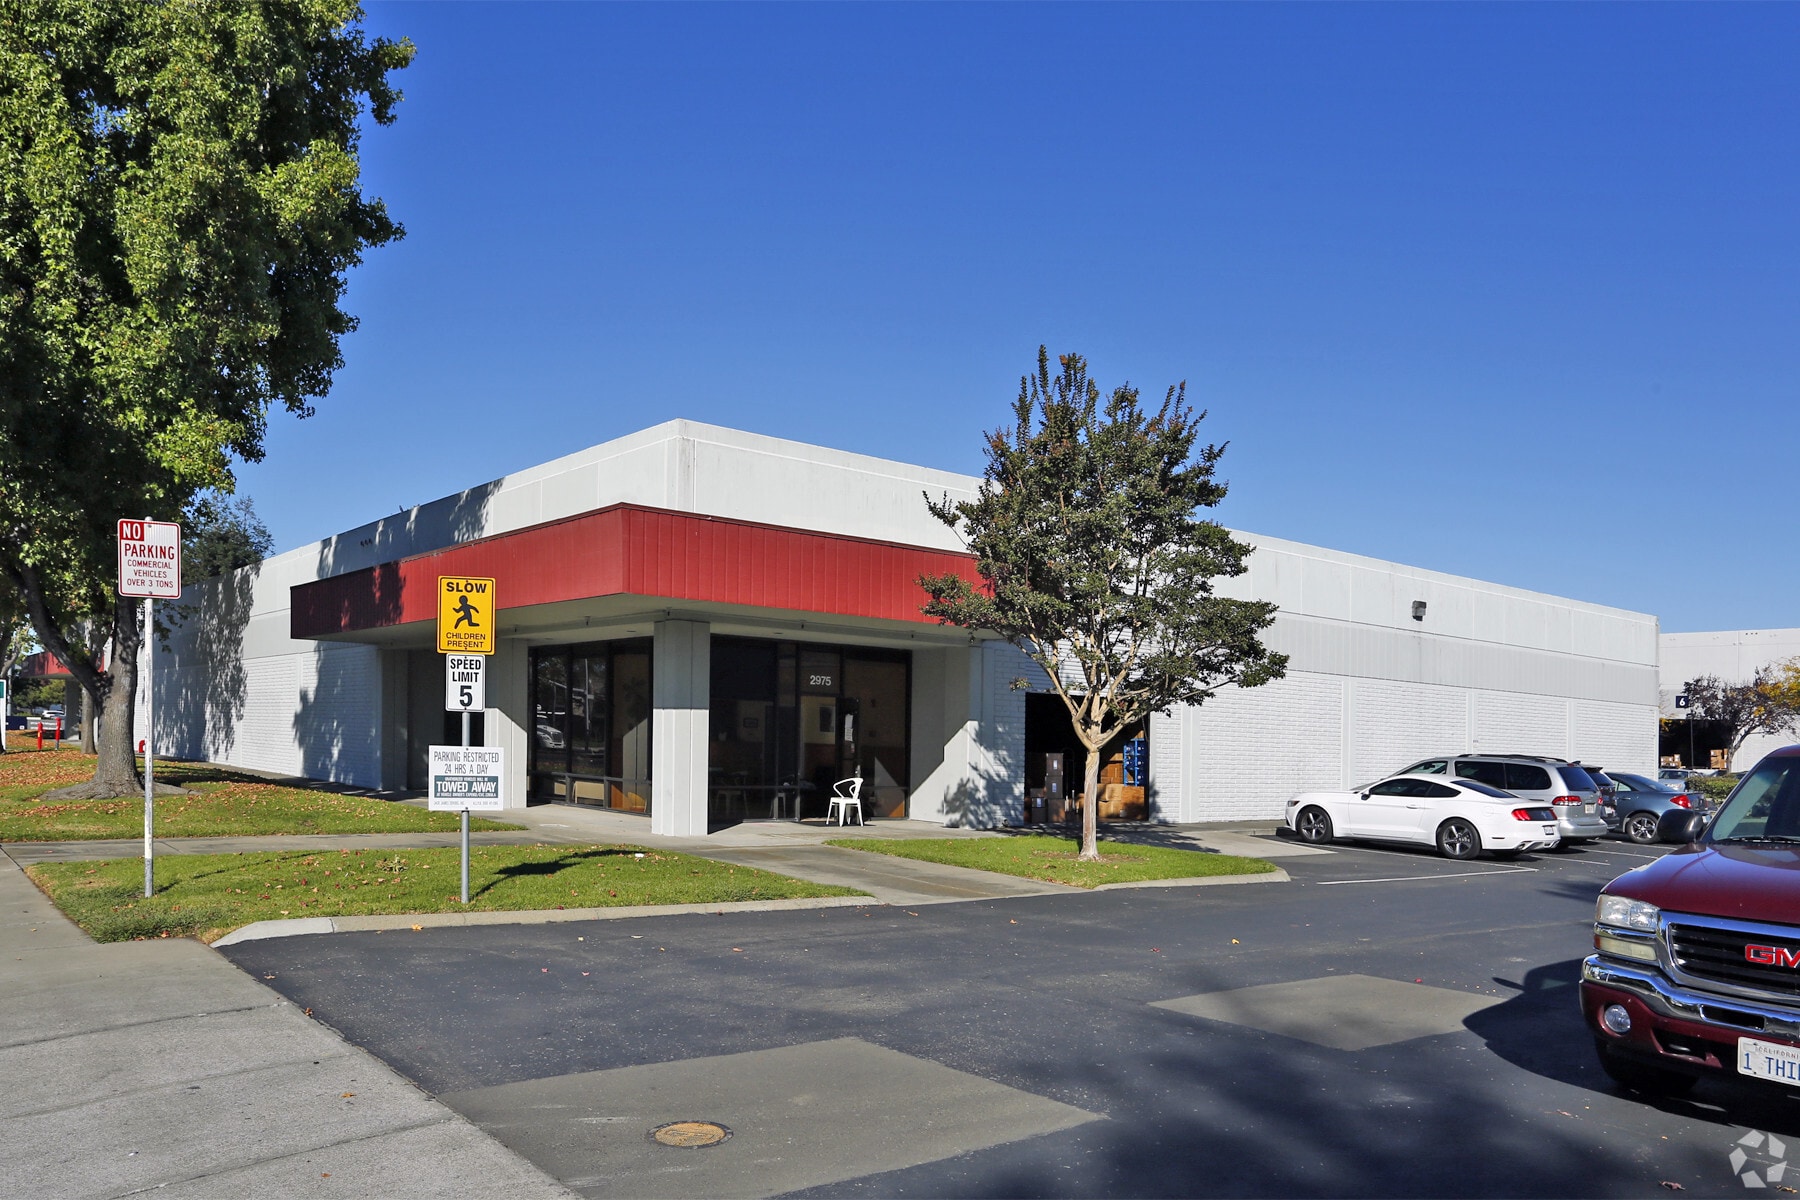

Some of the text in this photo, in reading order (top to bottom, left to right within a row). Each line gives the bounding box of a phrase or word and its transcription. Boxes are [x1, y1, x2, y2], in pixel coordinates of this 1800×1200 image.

[123, 523, 141, 539] NO
[124, 543, 175, 560] PARKING
[127, 559, 172, 569] COMMERCIAL
[133, 570, 167, 578] VEHICLES
[127, 578, 145, 587] OVER
[156, 580, 173, 588] TONS
[446, 582, 487, 593] SLOW
[446, 632, 486, 640] CHILDREN
[450, 659, 481, 670] SPEED
[452, 671, 479, 682] LIMIT
[810, 675, 831, 686] 2975
[460, 685, 472, 707] 5
[1680, 698, 1685, 706] 6
[434, 751, 499, 763] PARKING RESTRICTED
[445, 764, 489, 774] 24 HRS A DAY
[436, 781, 496, 793] TOWED AWAY
[1765, 1056, 1800, 1081] THI
